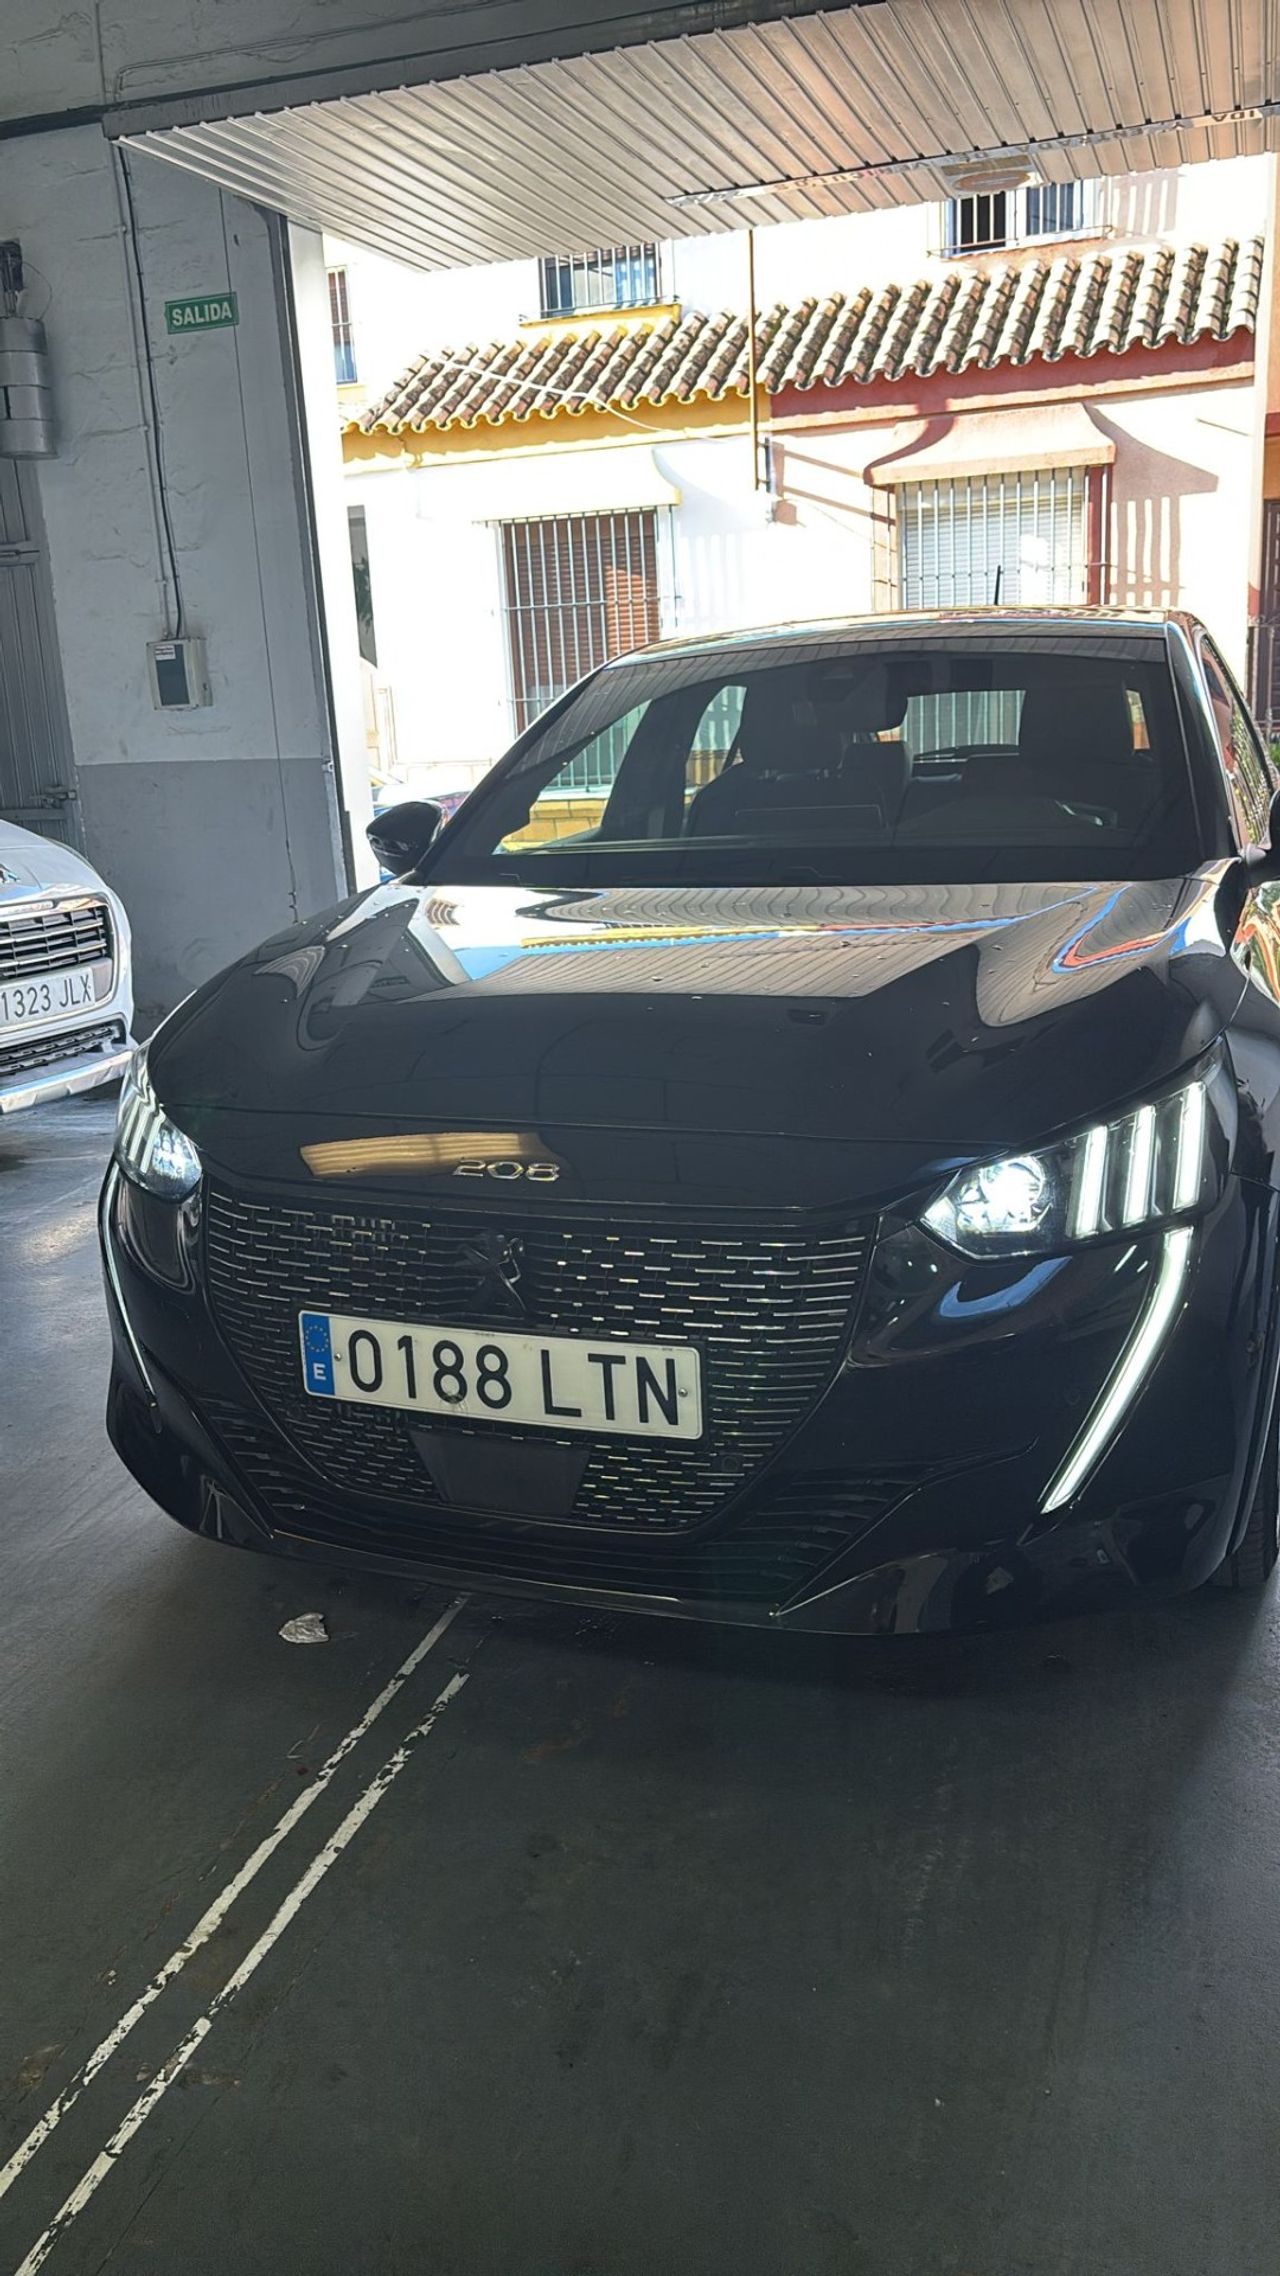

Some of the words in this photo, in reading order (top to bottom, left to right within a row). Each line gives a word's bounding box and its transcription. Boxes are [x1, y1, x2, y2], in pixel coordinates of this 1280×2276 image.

[172, 301, 232, 326] SALIDA
[1, 984, 51, 1020] 1323
[59, 974, 92, 1007] JLX
[452, 1159, 560, 1181] 208
[313, 1363, 326, 1380] E
[348, 1329, 512, 1409] 0188
[541, 1349, 680, 1426] LTN
